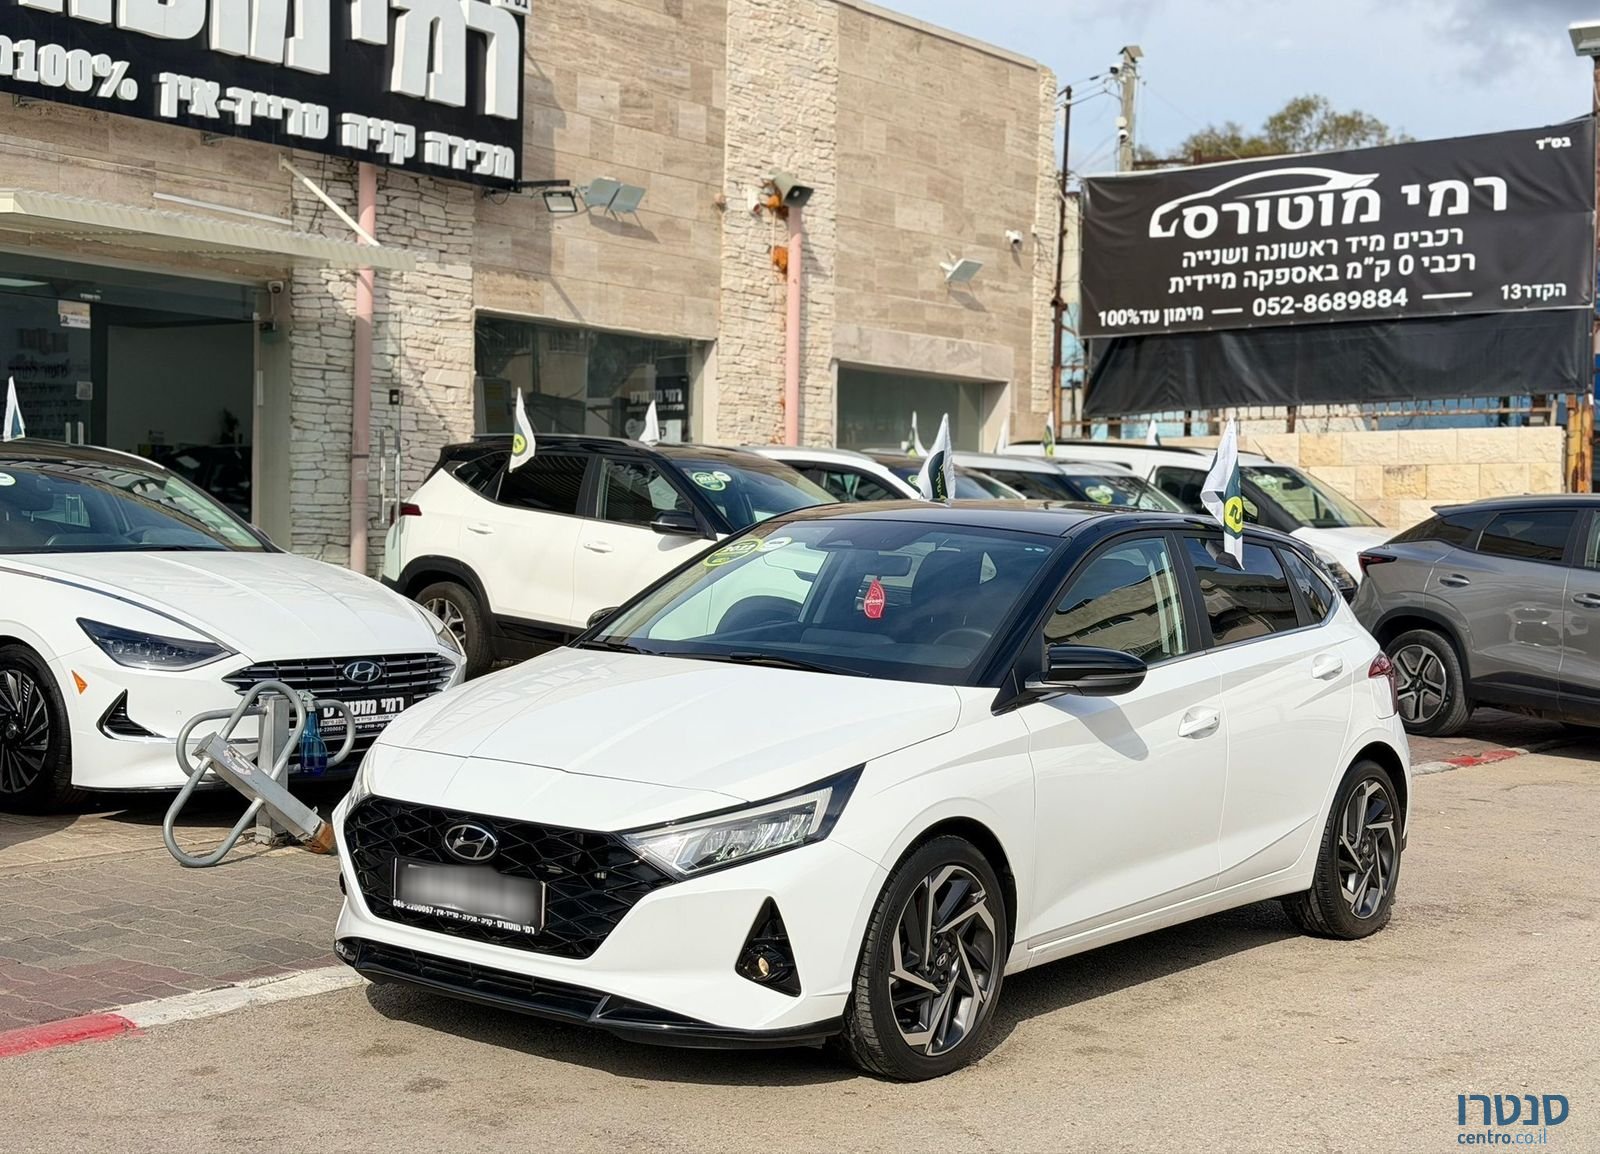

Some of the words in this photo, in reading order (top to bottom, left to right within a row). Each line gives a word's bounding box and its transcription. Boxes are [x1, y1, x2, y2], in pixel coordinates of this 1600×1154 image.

[157, 71, 329, 140] טרייד-אין
[341, 111, 416, 165] קניה
[424, 129, 515, 180] מכירה
[1401, 176, 1508, 217] רמי
[1182, 188, 1381, 239] מוטורס
[1255, 238, 1339, 262] ראשונה
[1345, 234, 1386, 254] מיד
[1393, 228, 1464, 250] רכבים
[1182, 246, 1249, 268] ושנייה
[1398, 254, 1415, 276] 0
[1421, 253, 1476, 274] רכבי
[1168, 272, 1237, 294] מיידית
[1243, 263, 1340, 291] באספקה
[1252, 287, 1408, 317] 052-8689884
[1163, 306, 1204, 326] מימון
[380, 696, 404, 713] רמי
